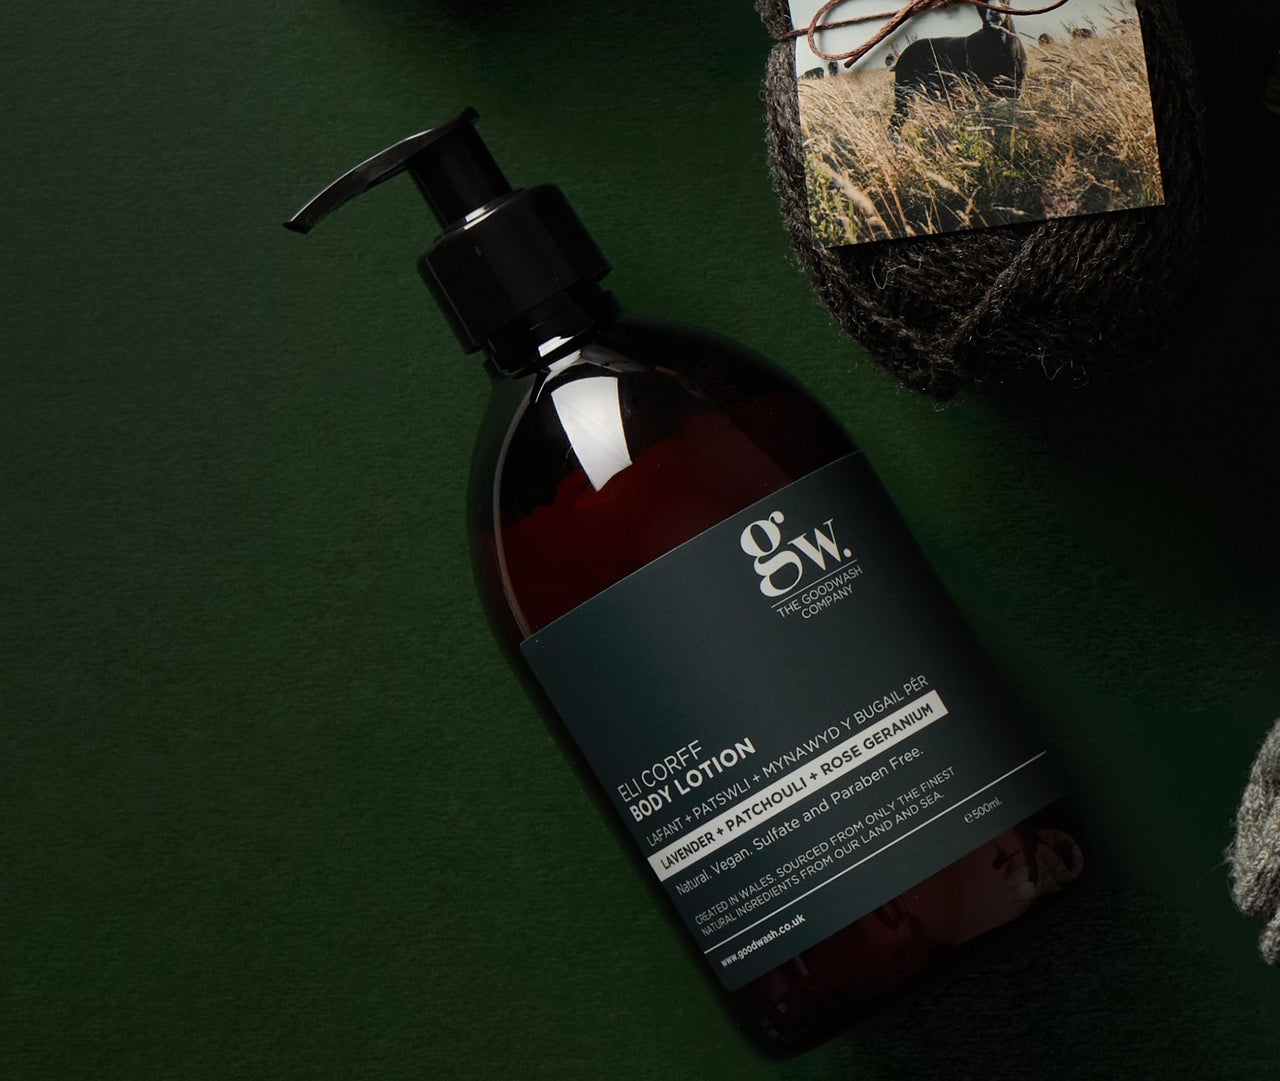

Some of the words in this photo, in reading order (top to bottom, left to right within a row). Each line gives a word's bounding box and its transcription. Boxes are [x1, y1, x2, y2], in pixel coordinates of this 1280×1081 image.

[776, 599, 802, 618] THE
[801, 565, 863, 605] GOODWASH
[801, 584, 854, 619] COMPANY
[617, 777, 643, 803] ELI
[641, 739, 702, 788] CORFF
[629, 785, 673, 823] BODY
[673, 737, 757, 796] LOTION
[645, 817, 685, 847] LAFANT
[691, 778, 751, 820] PATSWLI
[762, 726, 841, 779] MYNAWYD
[840, 717, 852, 731] Y
[853, 690, 905, 725] BUGAIL
[903, 675, 929, 696] PÊR
[660, 831, 716, 870] LAVENDER
[725, 777, 807, 832] PATCHOULI
[820, 745, 863, 776] ROSE
[863, 703, 934, 750] GERANIUM
[675, 868, 713, 896] Natural.
[711, 847, 753, 875] Vegan.
[752, 818, 801, 851] Sulfate
[802, 799, 830, 822] and
[830, 766, 889, 806] Paraben
[888, 746, 924, 771] Free.
[695, 901, 729, 926] CREATED
[728, 894, 740, 907] IN
[738, 873, 777, 901] WALES.
[776, 841, 829, 879] SOURCED
[829, 821, 865, 847] FROM
[865, 801, 897, 825] ONLY
[896, 787, 921, 806] THE
[919, 766, 956, 793] FINEST
[701, 913, 738, 937] NATURAL
[736, 874, 800, 918] INGREDIENTS
[799, 855, 834, 881] FROM
[834, 839, 861, 860] OUR
[860, 819, 894, 844] LAND
[895, 804, 919, 825] AND
[919, 791, 945, 809] SEA.
[720, 914, 806, 968] www.goodwash.co.uk
